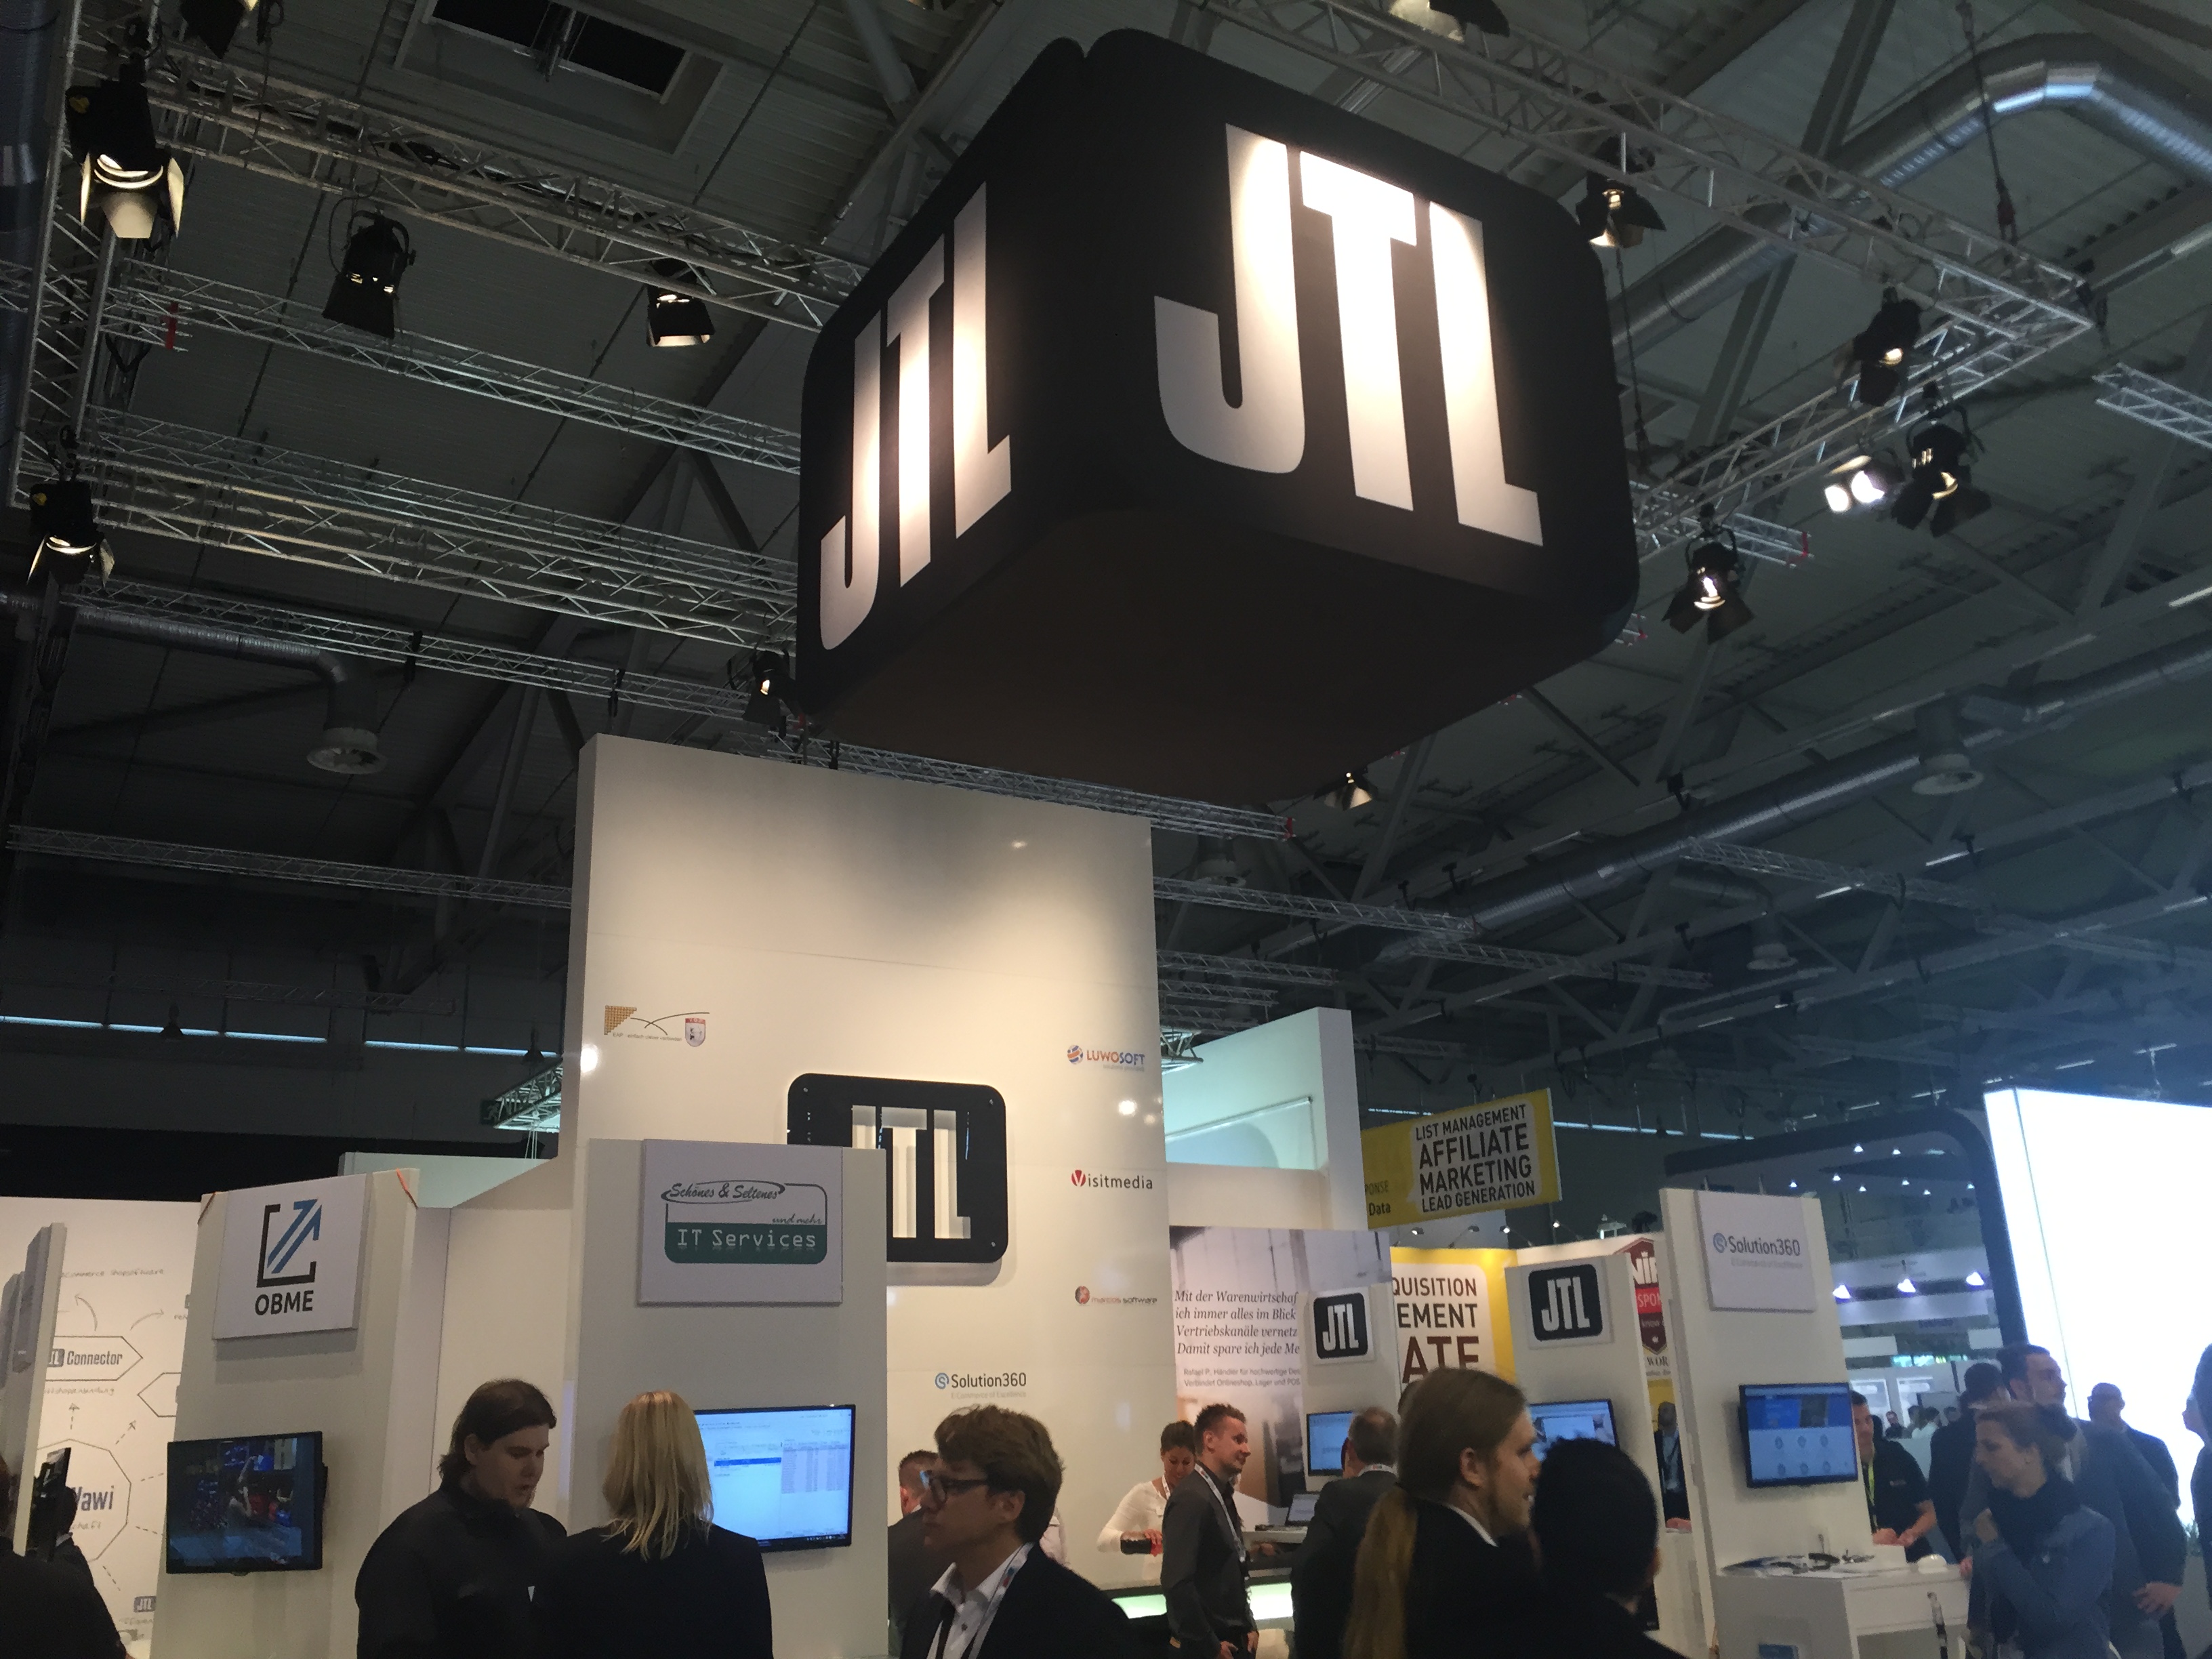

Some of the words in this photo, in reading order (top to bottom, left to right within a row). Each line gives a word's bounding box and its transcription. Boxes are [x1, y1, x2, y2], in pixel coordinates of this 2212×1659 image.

[1153, 122, 1544, 547] JTL
[819, 181, 1012, 651] JTL
[1086, 1050, 1145, 1065] LUWOSOFT
[1416, 1122, 1439, 1141] LIST
[1442, 1104, 1526, 1136] MANAGEMENT
[1419, 1123, 1529, 1170] AFFILIATE
[1420, 1154, 1532, 1195] MARKETING
[670, 1183, 714, 1198] Schönes
[718, 1182, 729, 1198] &
[733, 1185, 778, 1200] Seltenes
[1422, 1193, 1452, 1212] LEAD
[1455, 1180, 1535, 1208] GENERATION
[1368, 1202, 1391, 1216] Data
[678, 1229, 702, 1246] IT
[712, 1229, 816, 1247] Services
[1728, 1235, 1801, 1256] Solution360
[1174, 1290, 1193, 1302] Mit
[1195, 1290, 1213, 1302] der
[1391, 1277, 1477, 1296] QUISITION
[255, 1290, 314, 1315] OBME
[1541, 1276, 1591, 1332] JTL
[1175, 1307, 1190, 1319] ich
[1193, 1307, 1228, 1319] immer
[1230, 1307, 1254, 1319] alles
[1256, 1308, 1269, 1319] im
[1272, 1308, 1296, 1320] Blick
[1397, 1303, 1478, 1328] EMENT
[1176, 1324, 1258, 1337] Vertriebskanäle
[1322, 1303, 1359, 1351] JTL
[66, 1351, 123, 1366] Connector
[1177, 1343, 1210, 1354] Damit
[1212, 1344, 1242, 1357] spare
[1244, 1342, 1258, 1354] ich
[1260, 1342, 1282, 1357] jede
[951, 1372, 1027, 1389] Solution360
